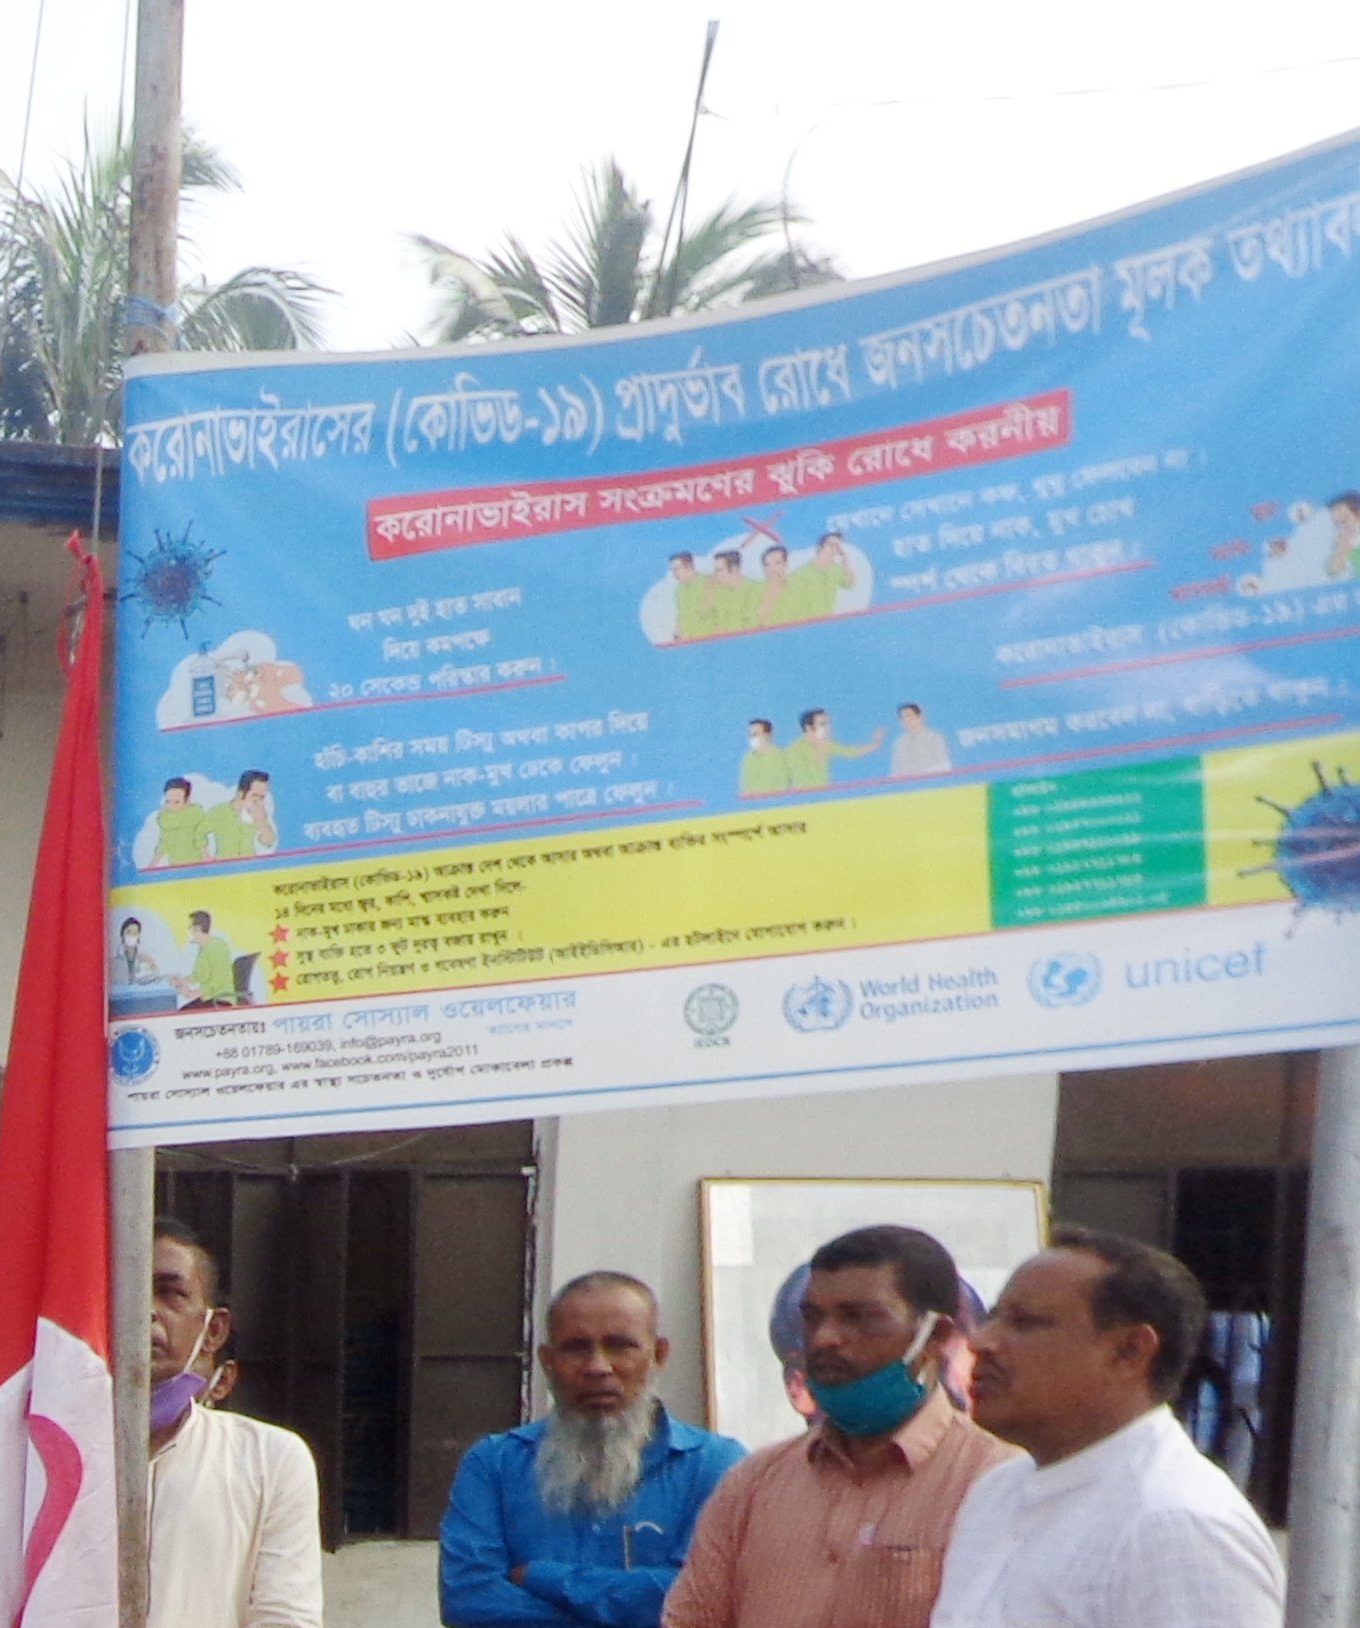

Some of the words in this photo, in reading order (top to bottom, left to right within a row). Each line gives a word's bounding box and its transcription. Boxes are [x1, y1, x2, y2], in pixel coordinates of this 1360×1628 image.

[125, 385, 376, 483] করোনাভাইরাসের
[386, 373, 605, 469] (কোভিড-১৯)
[615, 346, 747, 445] প্রাদুর্ভাব
[759, 344, 852, 415] রোধে
[859, 261, 1103, 388] জনসচেতনতা
[1114, 236, 1213, 342] মূলক
[375, 490, 589, 543] করোনাভাইরাস
[599, 468, 755, 512] সংক্রমণের
[847, 434, 934, 475] রোধে
[945, 402, 1061, 452] করনীয়
[329, 682, 354, 699] ২০
[409, 734, 450, 756] সময়
[500, 726, 550, 747] অথবা
[272, 875, 350, 897] করোনাভাইরাস
[354, 866, 429, 891] (কোভিড-১৯)
[859, 973, 920, 999] World
[928, 966, 998, 993] Health
[1125, 941, 1267, 990] unicef
[272, 1010, 334, 1036] পায়রা
[340, 1001, 429, 1032] সোস্যাল
[441, 989, 577, 1020] ওয়েলফেয়ার
[860, 989, 1000, 1024] Organization
[339, 1031, 442, 1052] info@payra.org
[181, 1061, 278, 1082] www.payra.org,
[281, 1043, 479, 1074] www.facebook.com/payra2011
